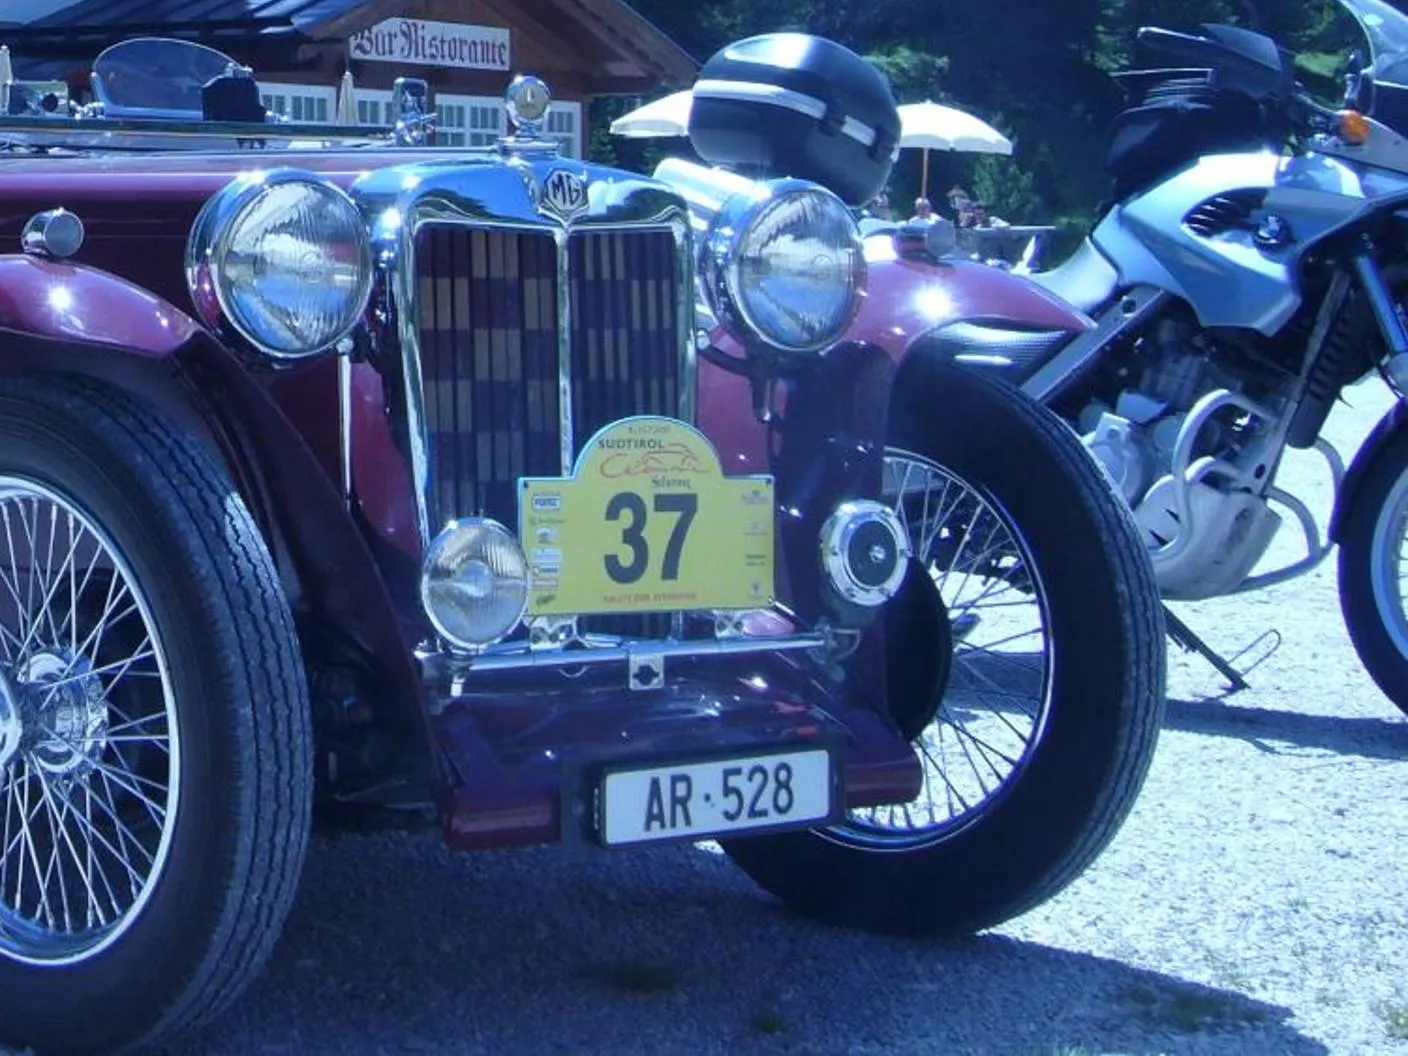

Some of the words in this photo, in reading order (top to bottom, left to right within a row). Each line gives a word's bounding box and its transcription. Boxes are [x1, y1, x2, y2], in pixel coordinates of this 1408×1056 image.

[352, 28, 398, 57] Bar
[399, 20, 508, 67] Ristorante
[551, 173, 581, 206] MG
[603, 491, 699, 585] 37
